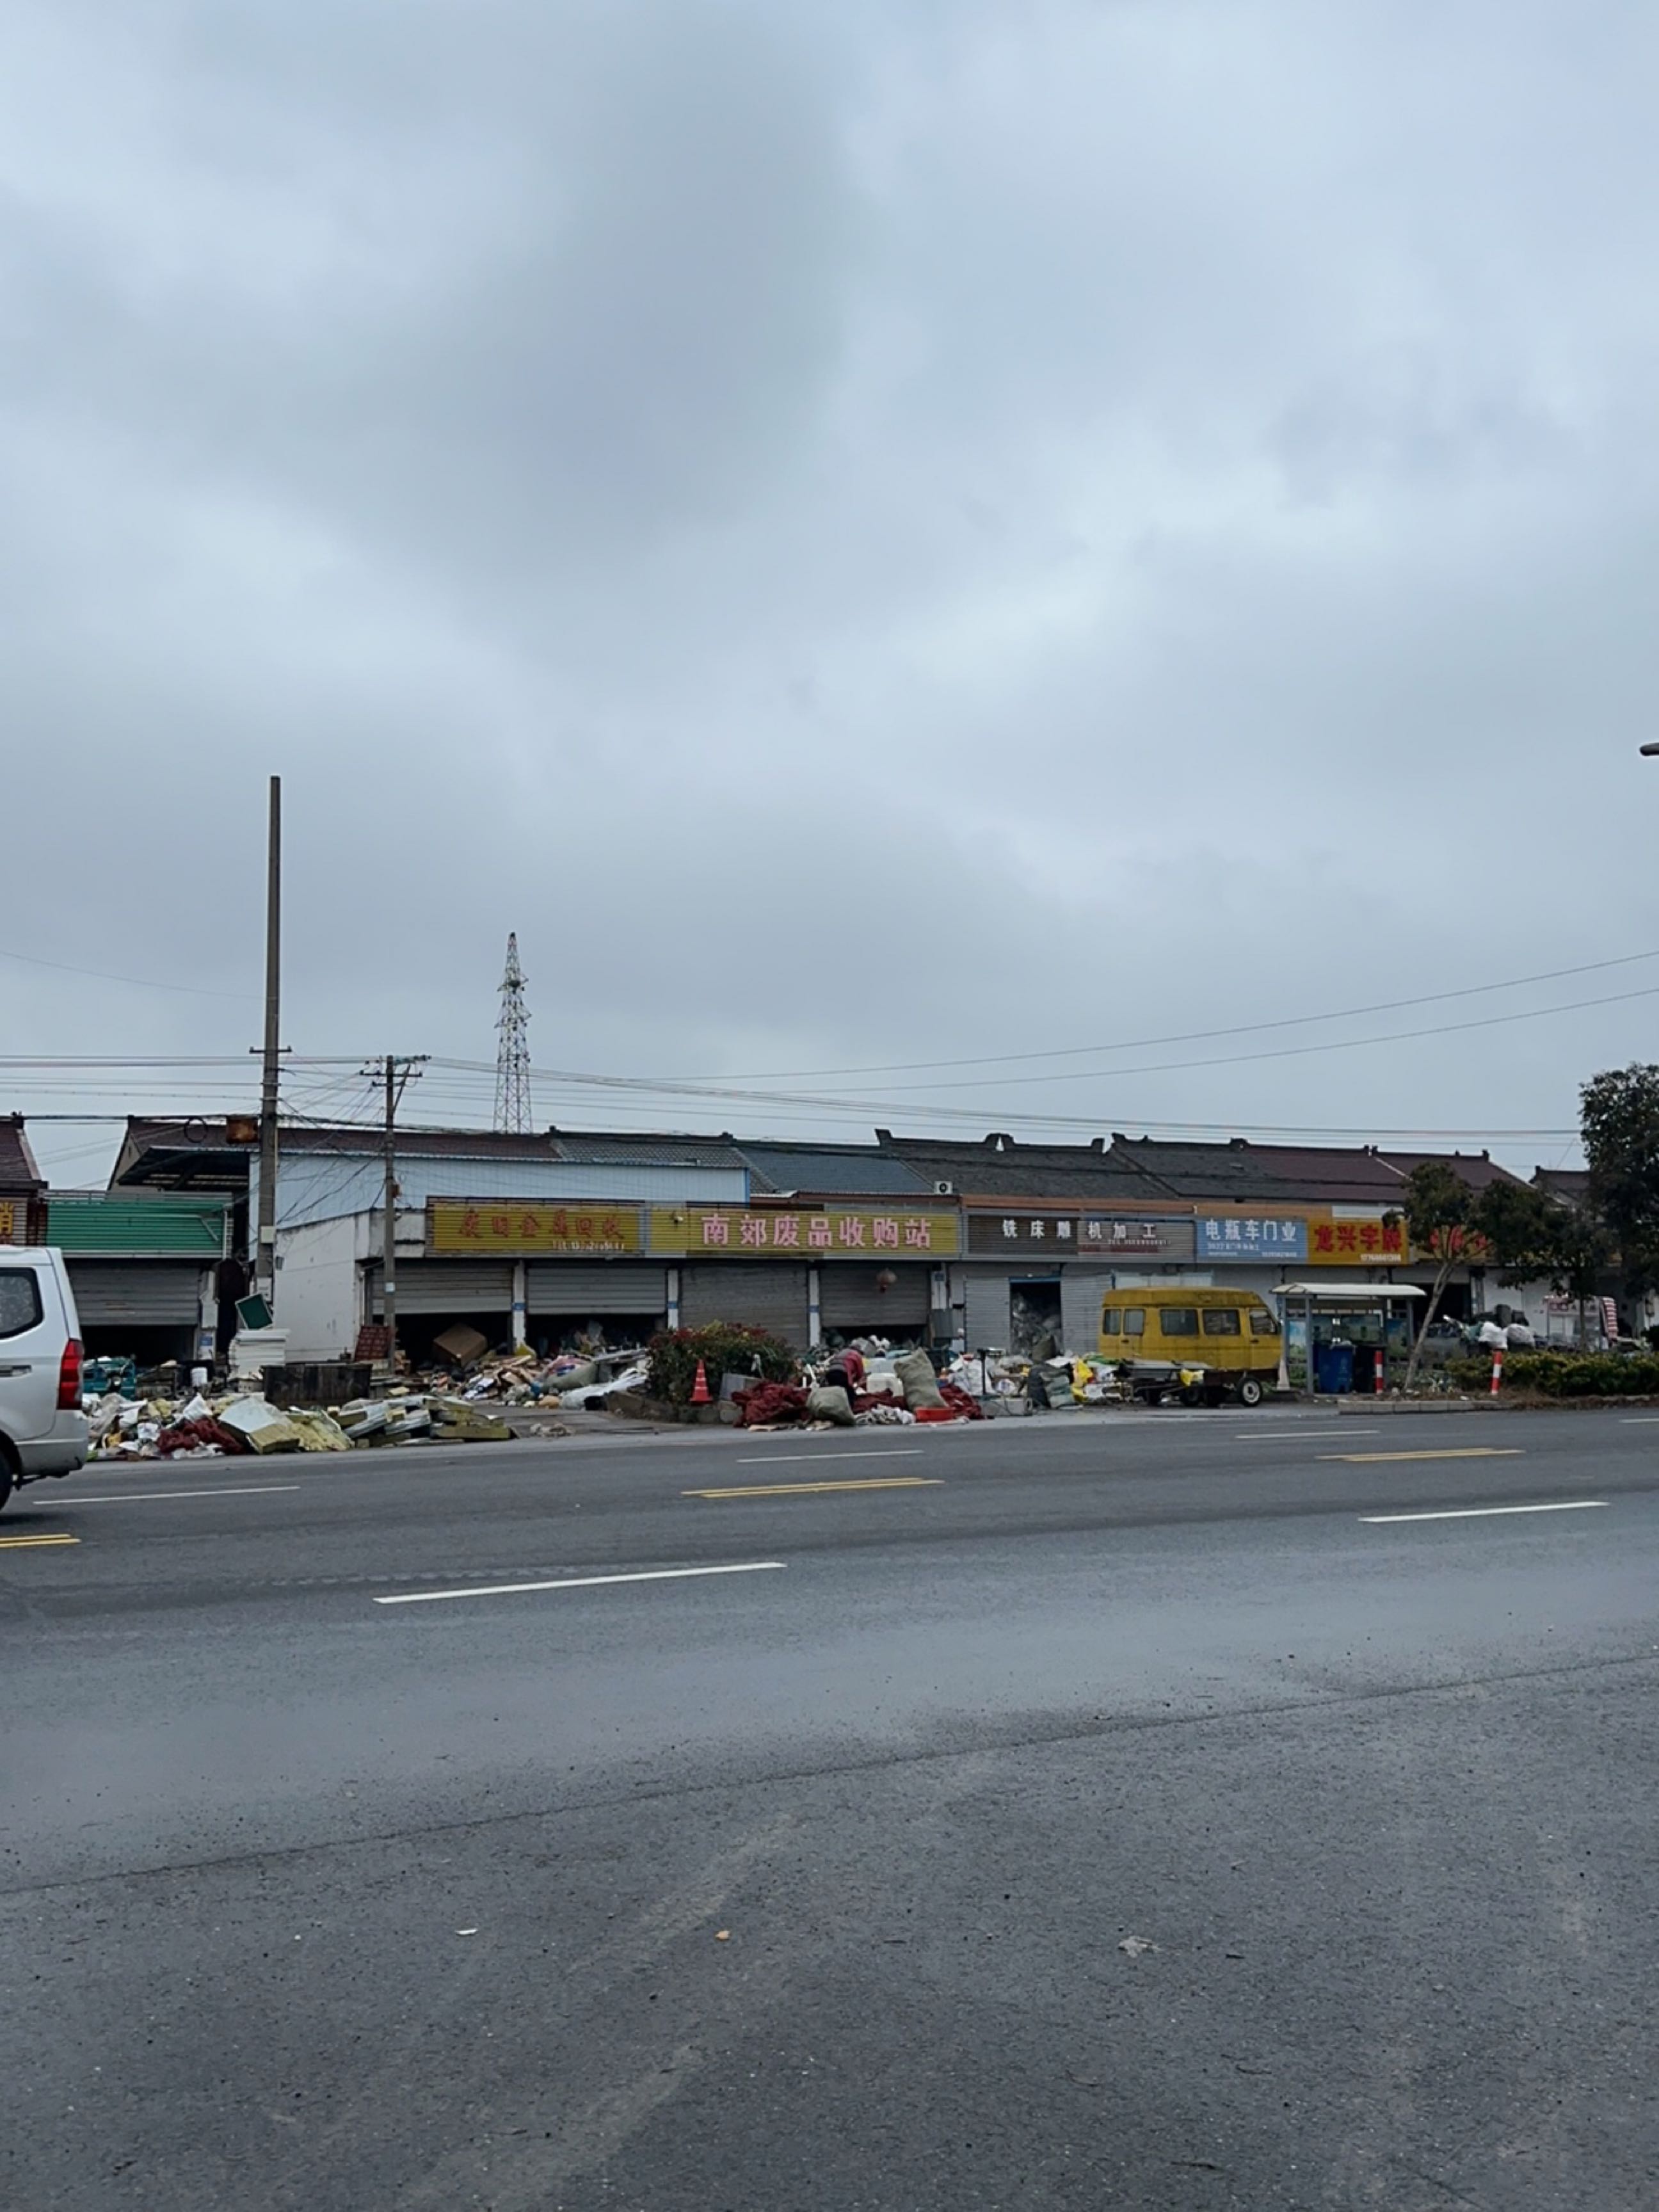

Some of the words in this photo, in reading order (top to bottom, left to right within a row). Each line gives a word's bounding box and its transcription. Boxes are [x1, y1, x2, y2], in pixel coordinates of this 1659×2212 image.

[701, 1214, 931, 1247] 南郊废品收购站
[1205, 1219, 1297, 1241] 电瓶车门业
